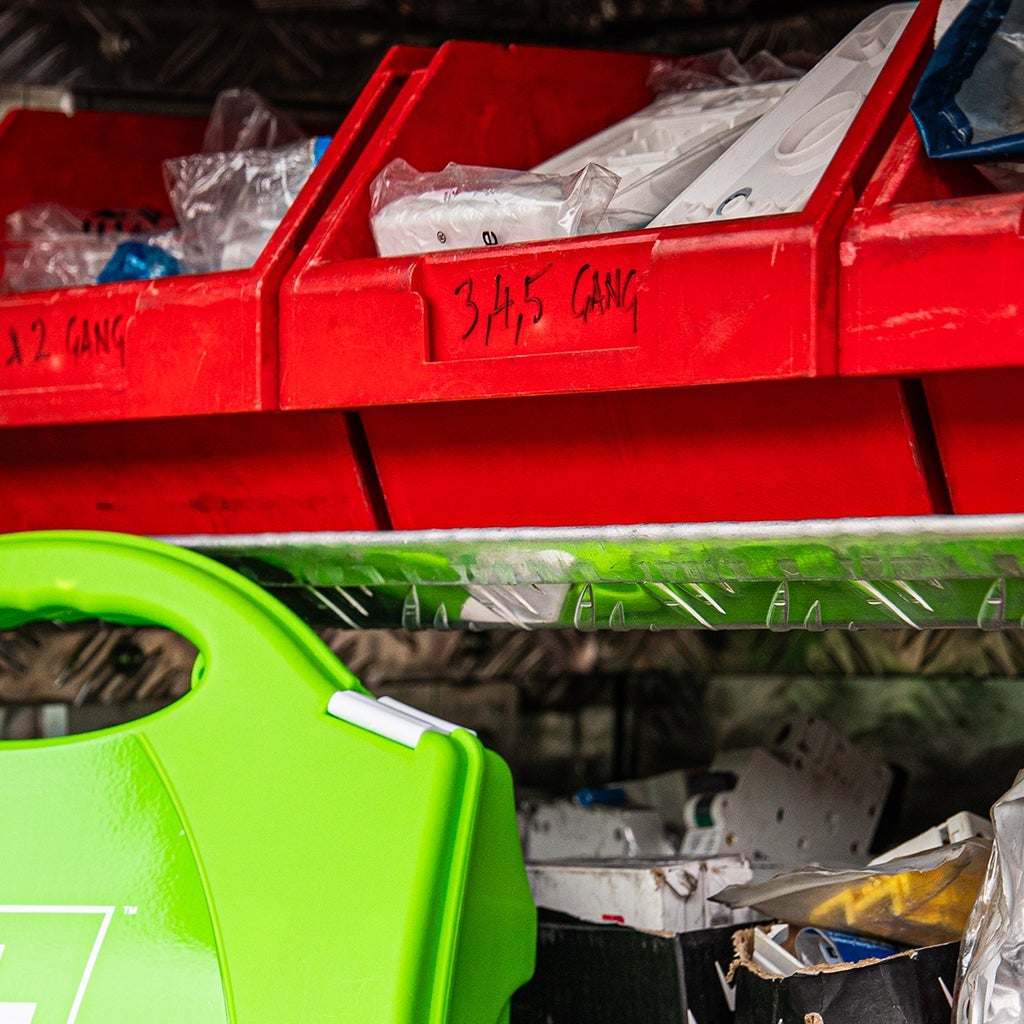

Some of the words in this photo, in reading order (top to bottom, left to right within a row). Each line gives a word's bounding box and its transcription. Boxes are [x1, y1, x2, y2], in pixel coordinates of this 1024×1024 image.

[454, 262, 553, 346] 3,4,5
[571, 263, 638, 334] GANG
[31, 317, 51, 362] 2
[65, 314, 126, 369] GANG
